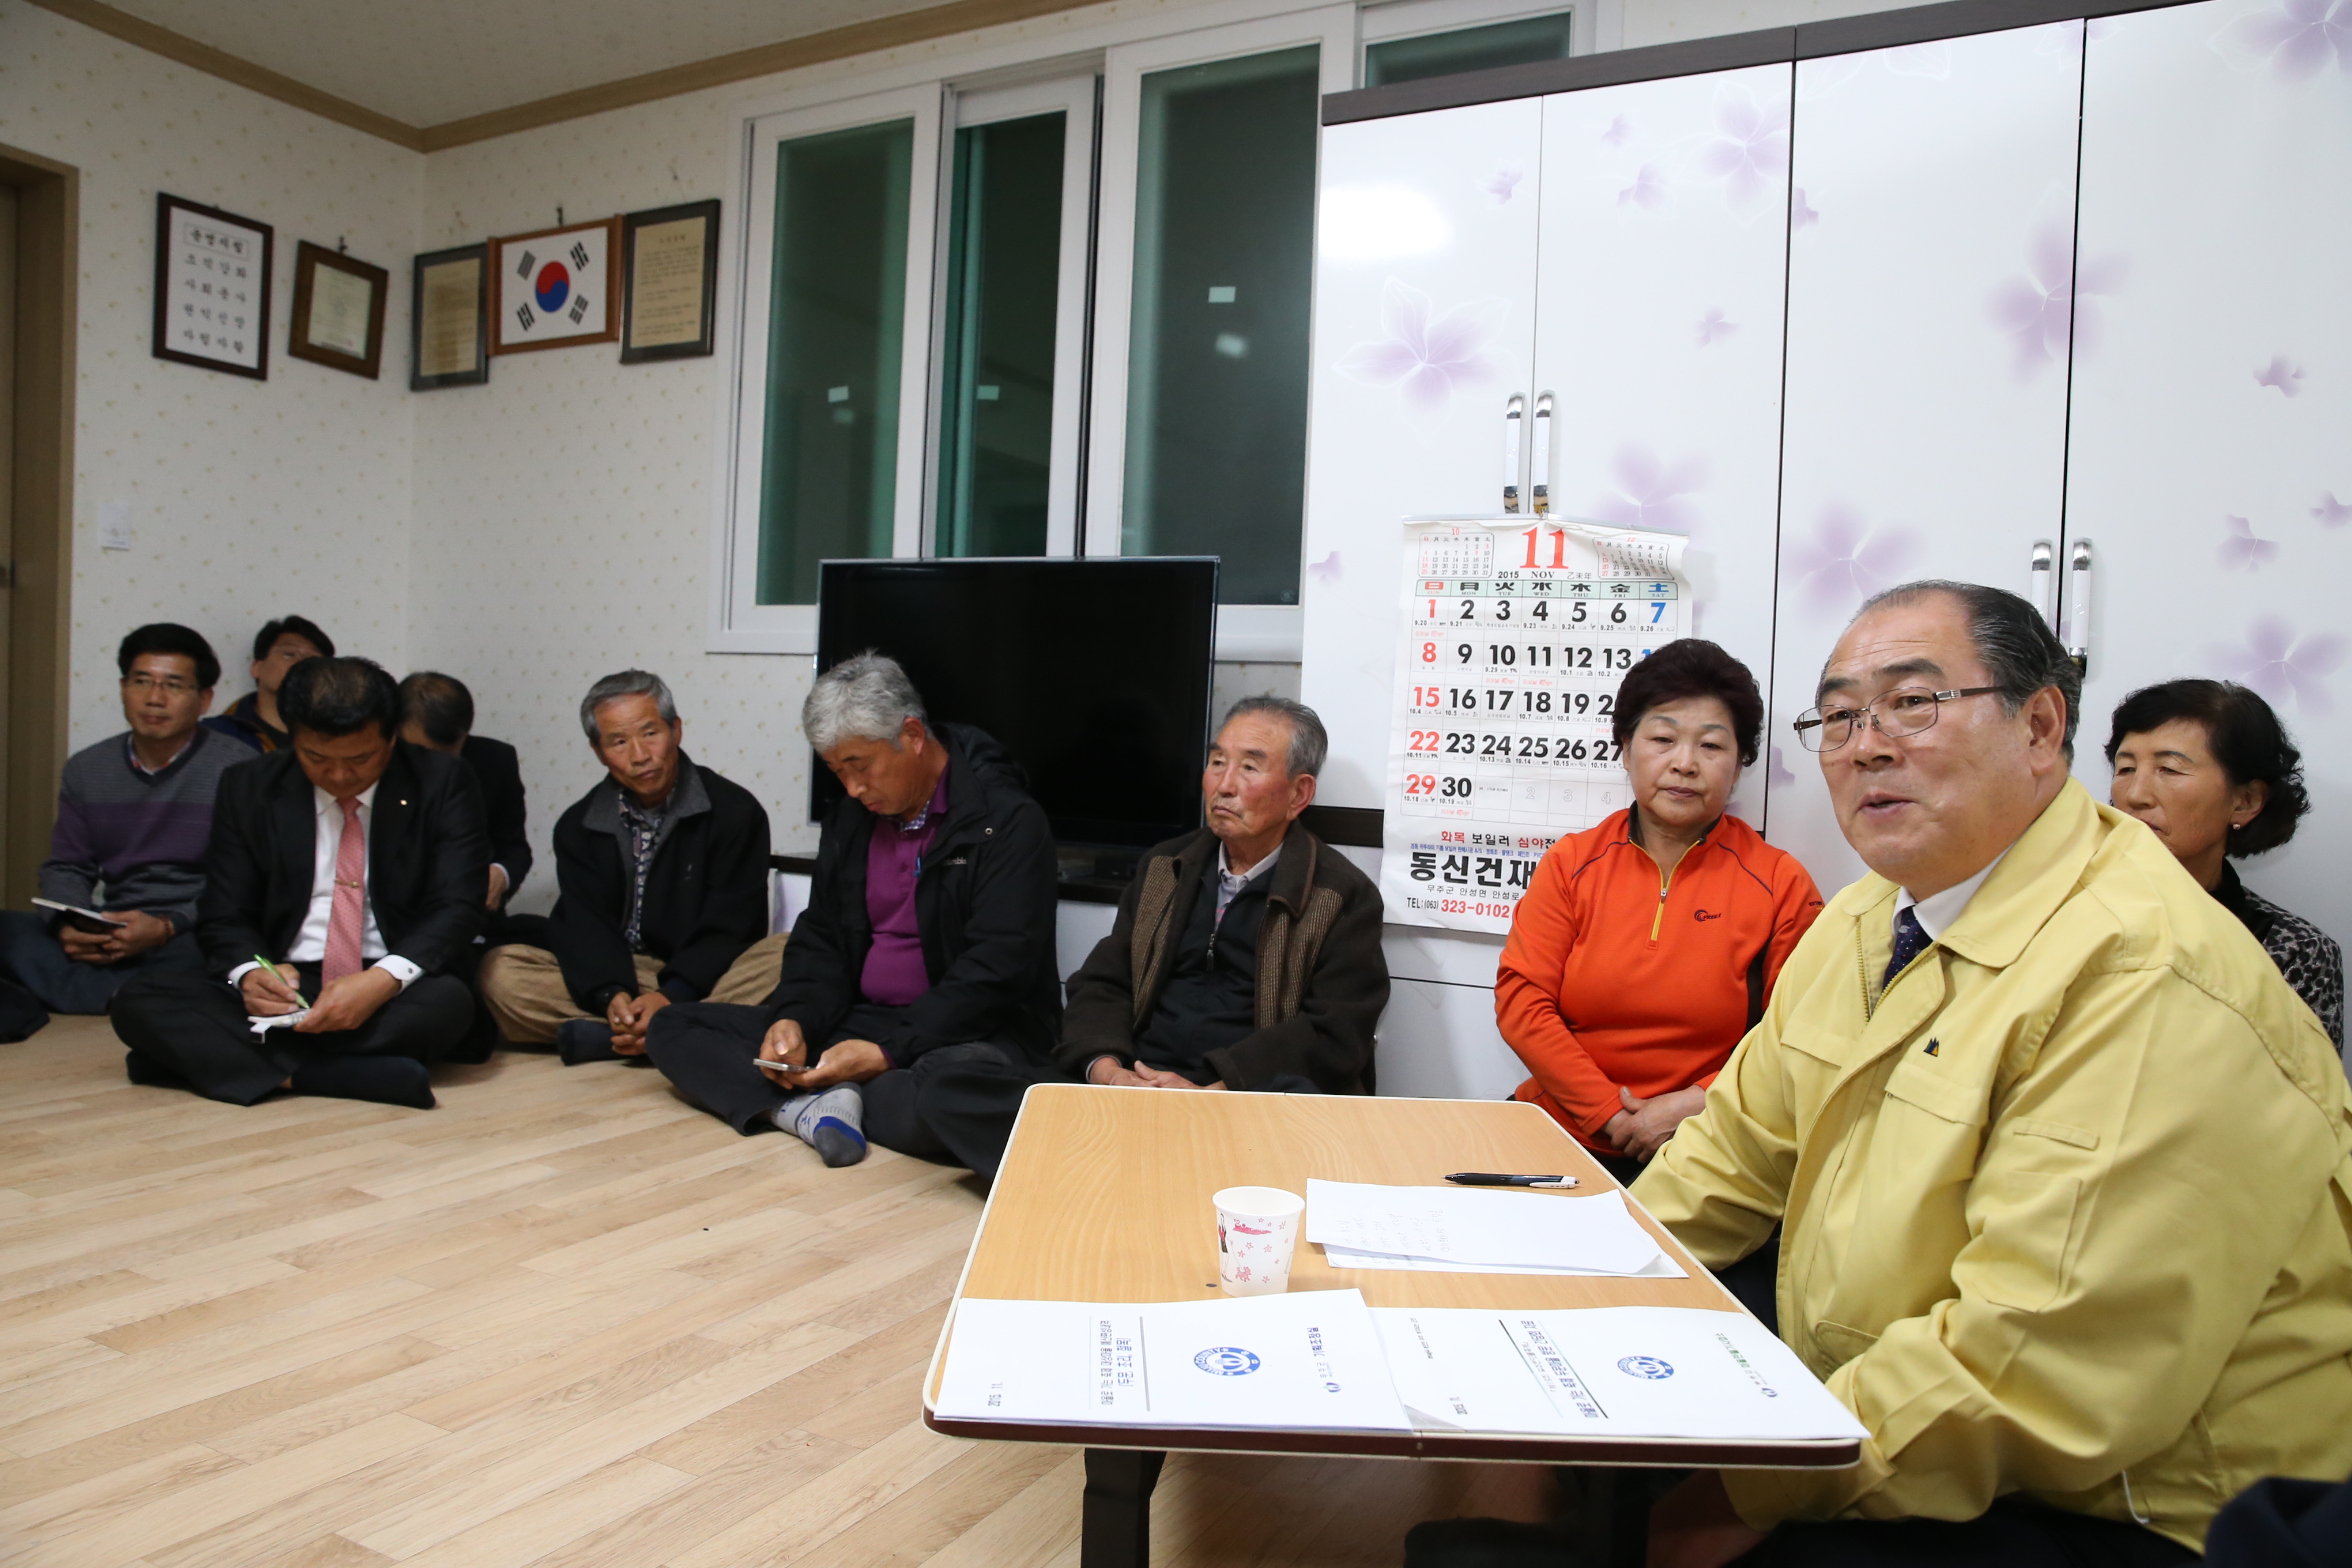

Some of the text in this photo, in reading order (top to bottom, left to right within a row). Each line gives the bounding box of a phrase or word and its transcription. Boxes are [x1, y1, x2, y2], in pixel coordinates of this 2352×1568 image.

[1452, 527, 1460, 536] 10
[1520, 527, 1569, 569] 11
[1425, 581, 1669, 593] 日 月 火 水 木 金 土
[1427, 599, 1666, 623] 1 2 3 4 5 6 7
[1422, 642, 1436, 662] 8
[1458, 644, 1472, 664] 9
[1490, 645, 1516, 666] 10
[1527, 646, 1551, 666] 11
[1564, 647, 1592, 668] 12
[1603, 649, 1632, 670] 13
[1414, 687, 1615, 715] 15 16 17 18 19 2
[1409, 730, 1623, 761] 22 23 24 25 26 27
[1406, 774, 1471, 798] 29 30
[1441, 830, 1465, 843] 화목
[1472, 834, 1509, 847] 보일러
[1427, 885, 1520, 900] 무주군 안성면 안성로
[1441, 899, 1509, 918] 323-0102
